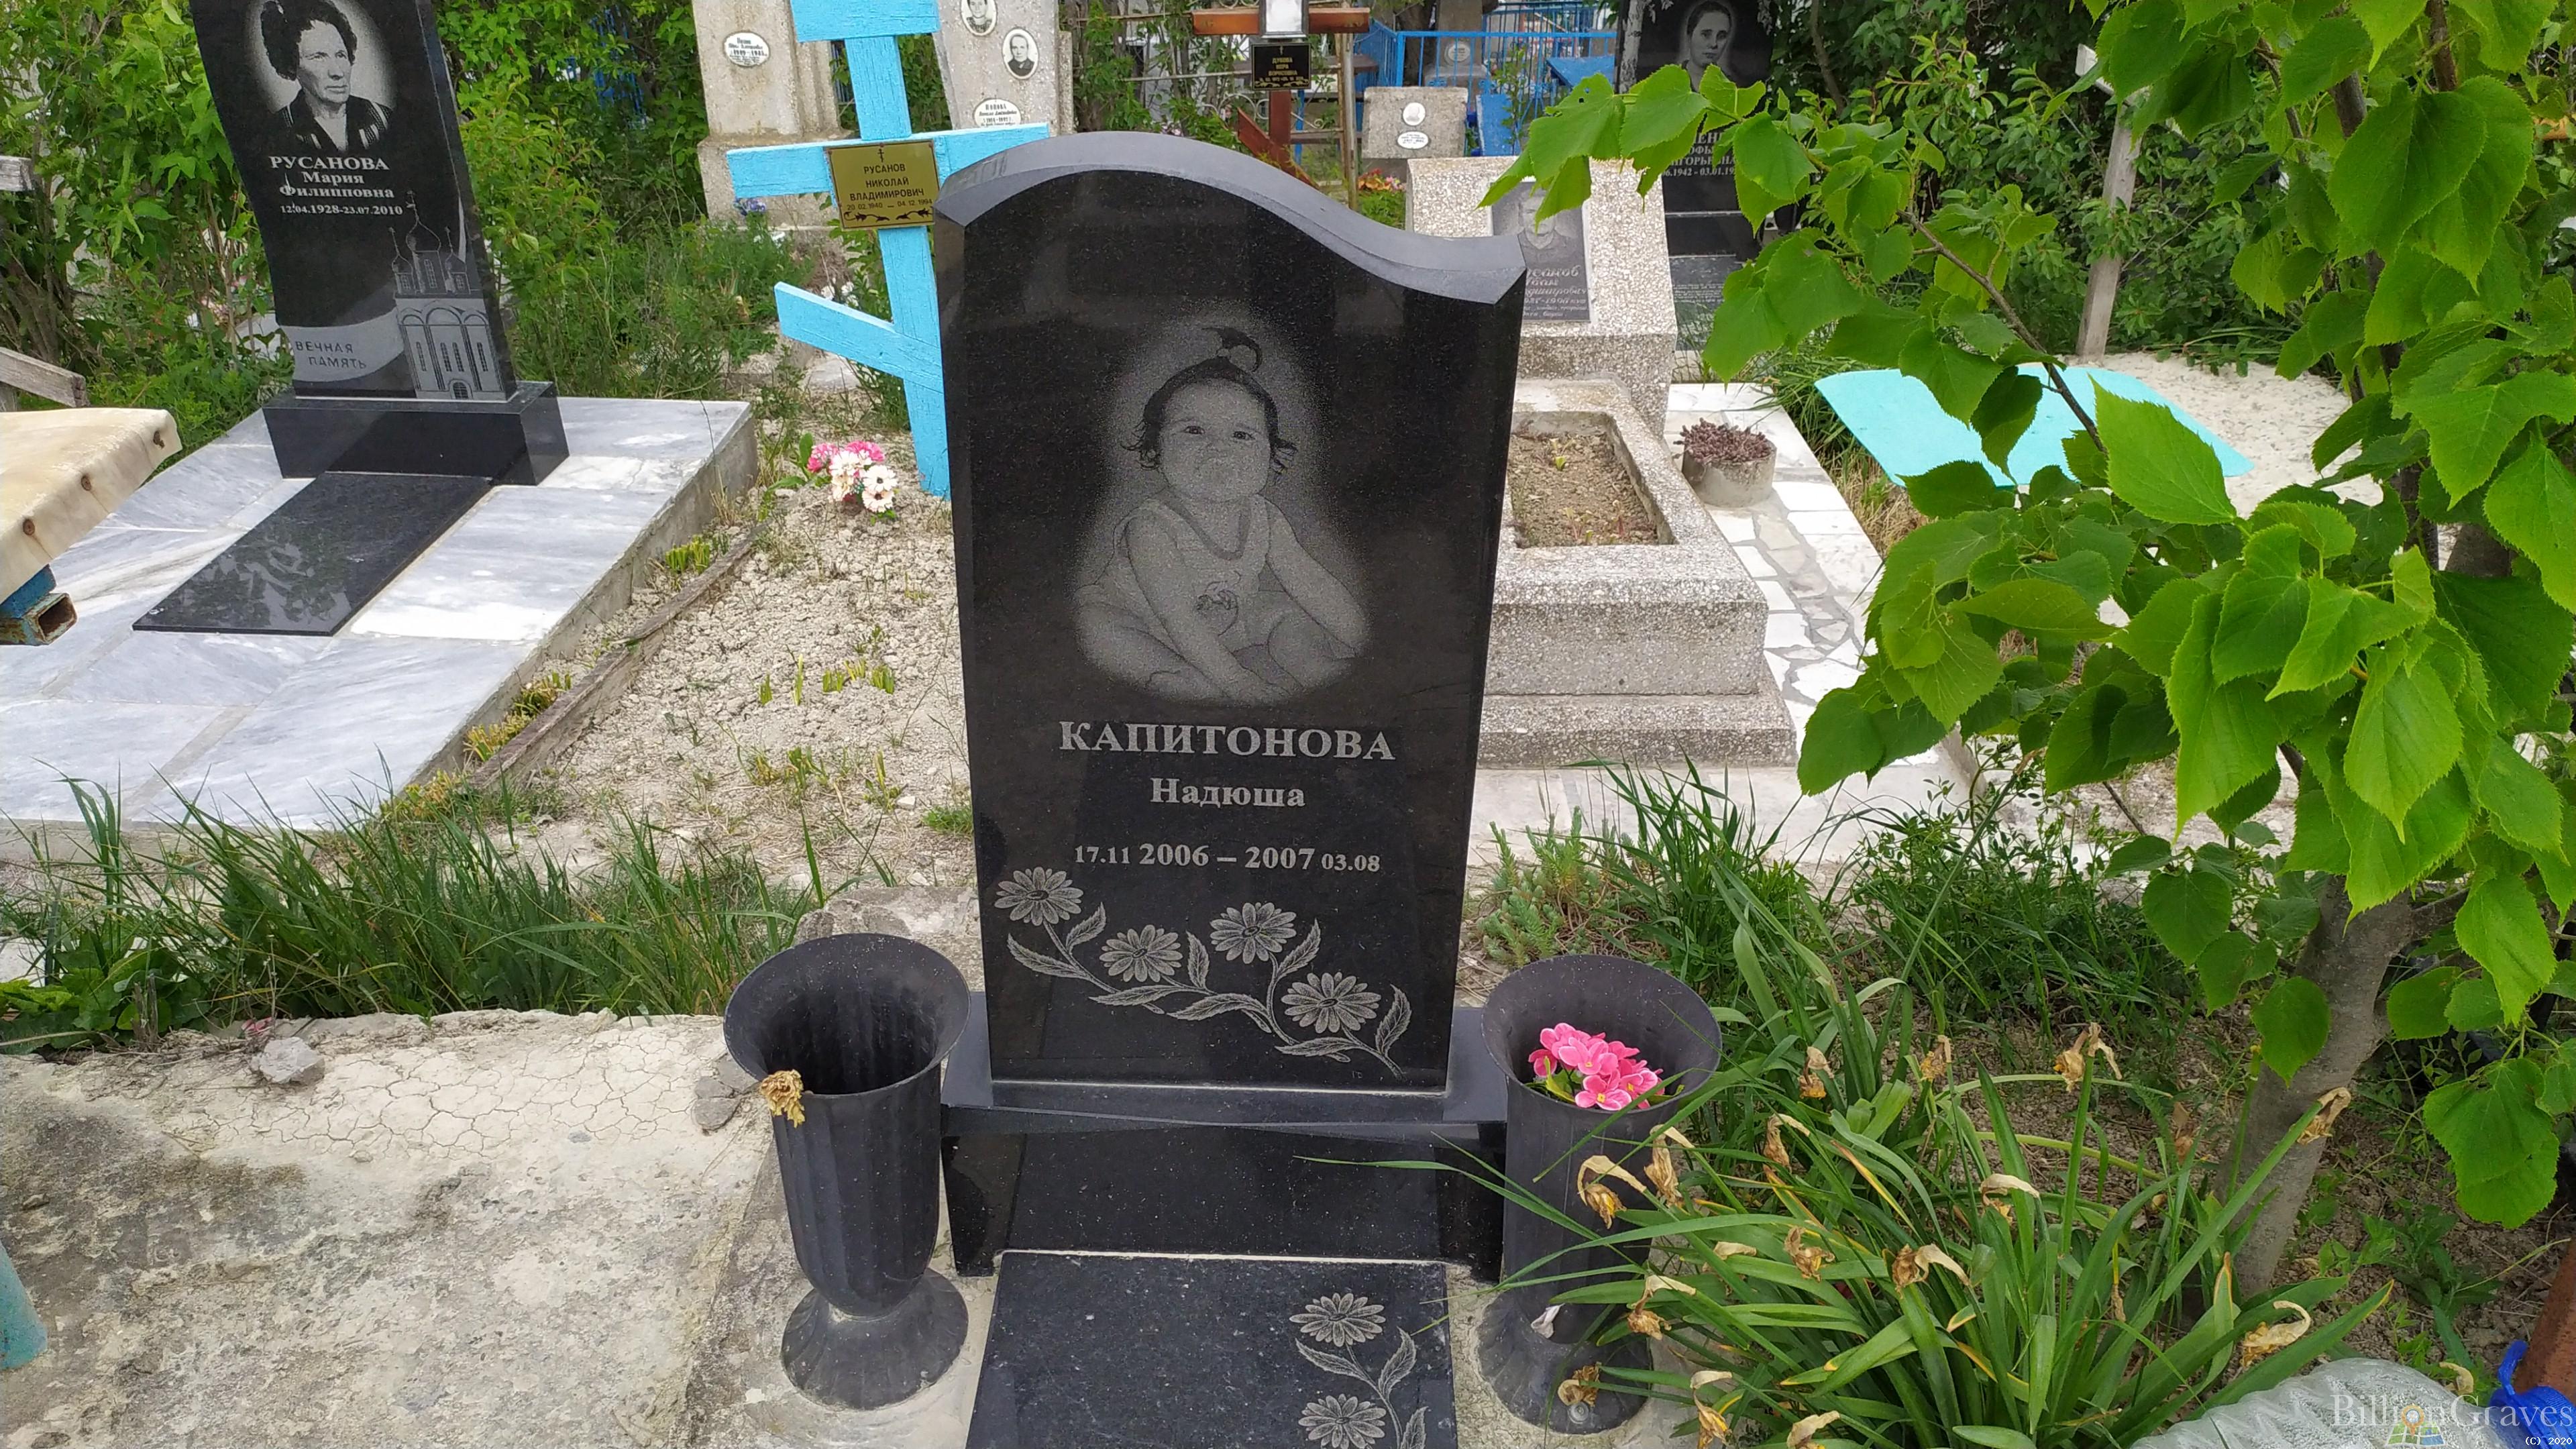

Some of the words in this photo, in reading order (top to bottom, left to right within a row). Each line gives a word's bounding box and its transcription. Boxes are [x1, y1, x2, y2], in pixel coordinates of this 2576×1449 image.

[268, 156, 390, 170] РУСАНОВА
[863, 164, 906, 174] РУСАНОВ
[301, 171, 365, 186] Мария
[865, 176, 909, 188] НИКОЛАЙ
[279, 184, 394, 199] Филипповна
[849, 188, 924, 201] ВЛАДИМИРОВИЧ
[295, 341, 353, 354] ВЕЧНАЯ
[309, 356, 366, 369] ПАМЯТЬ
[1059, 720, 1395, 761] КАПИТОНОВА
[1150, 777, 1305, 808] Надюша
[1075, 845, 1130, 864] 17.11
[1139, 843, 1209, 866] 2006
[1244, 846, 1315, 870] 2007
[1321, 853, 1380, 872] 03.08
